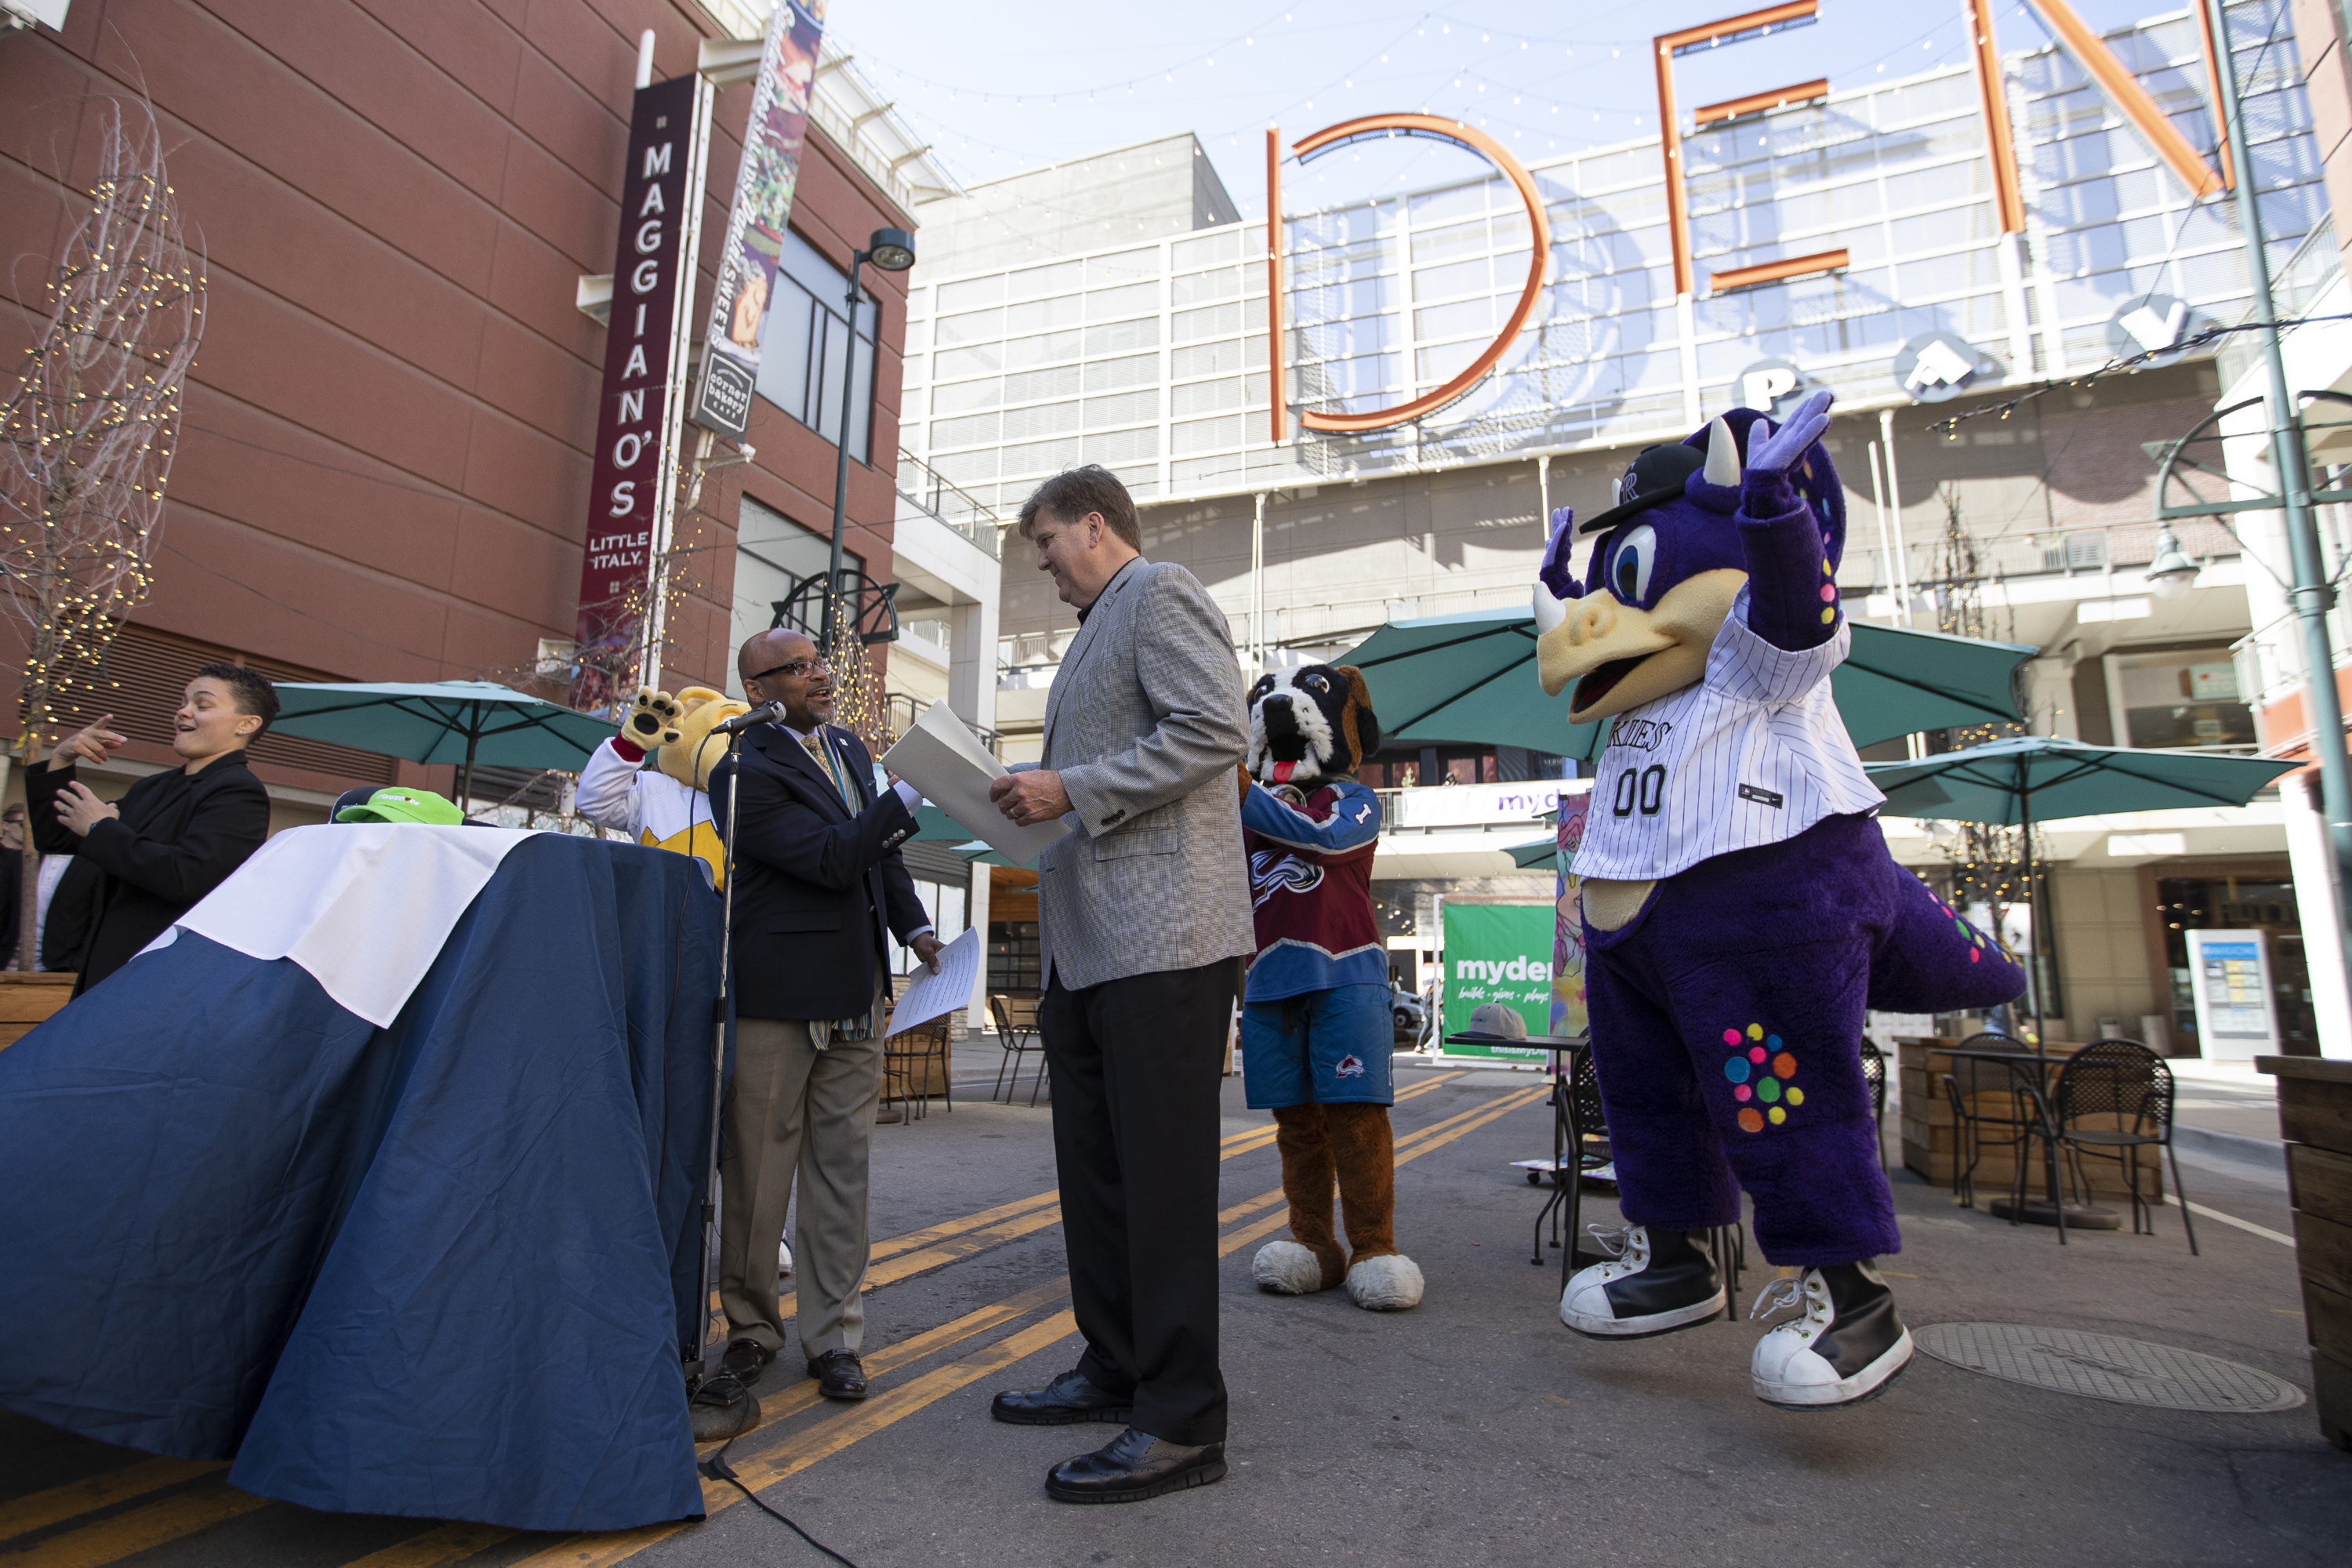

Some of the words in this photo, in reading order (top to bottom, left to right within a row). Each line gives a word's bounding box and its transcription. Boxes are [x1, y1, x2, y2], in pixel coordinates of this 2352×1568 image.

[742, 121, 767, 194] SALADS
[726, 188, 758, 274] Panini
[608, 141, 673, 518] MAGGIANO'S
[710, 267, 737, 349] SWEETS
[709, 382, 745, 415] bakery
[710, 373, 747, 402] corner
[590, 532, 649, 552] LITTLE
[1613, 761, 1668, 819] 00
[1457, 955, 1552, 985] myde
[1458, 985, 1486, 1000] builds
[1492, 987, 1515, 1003] gives
